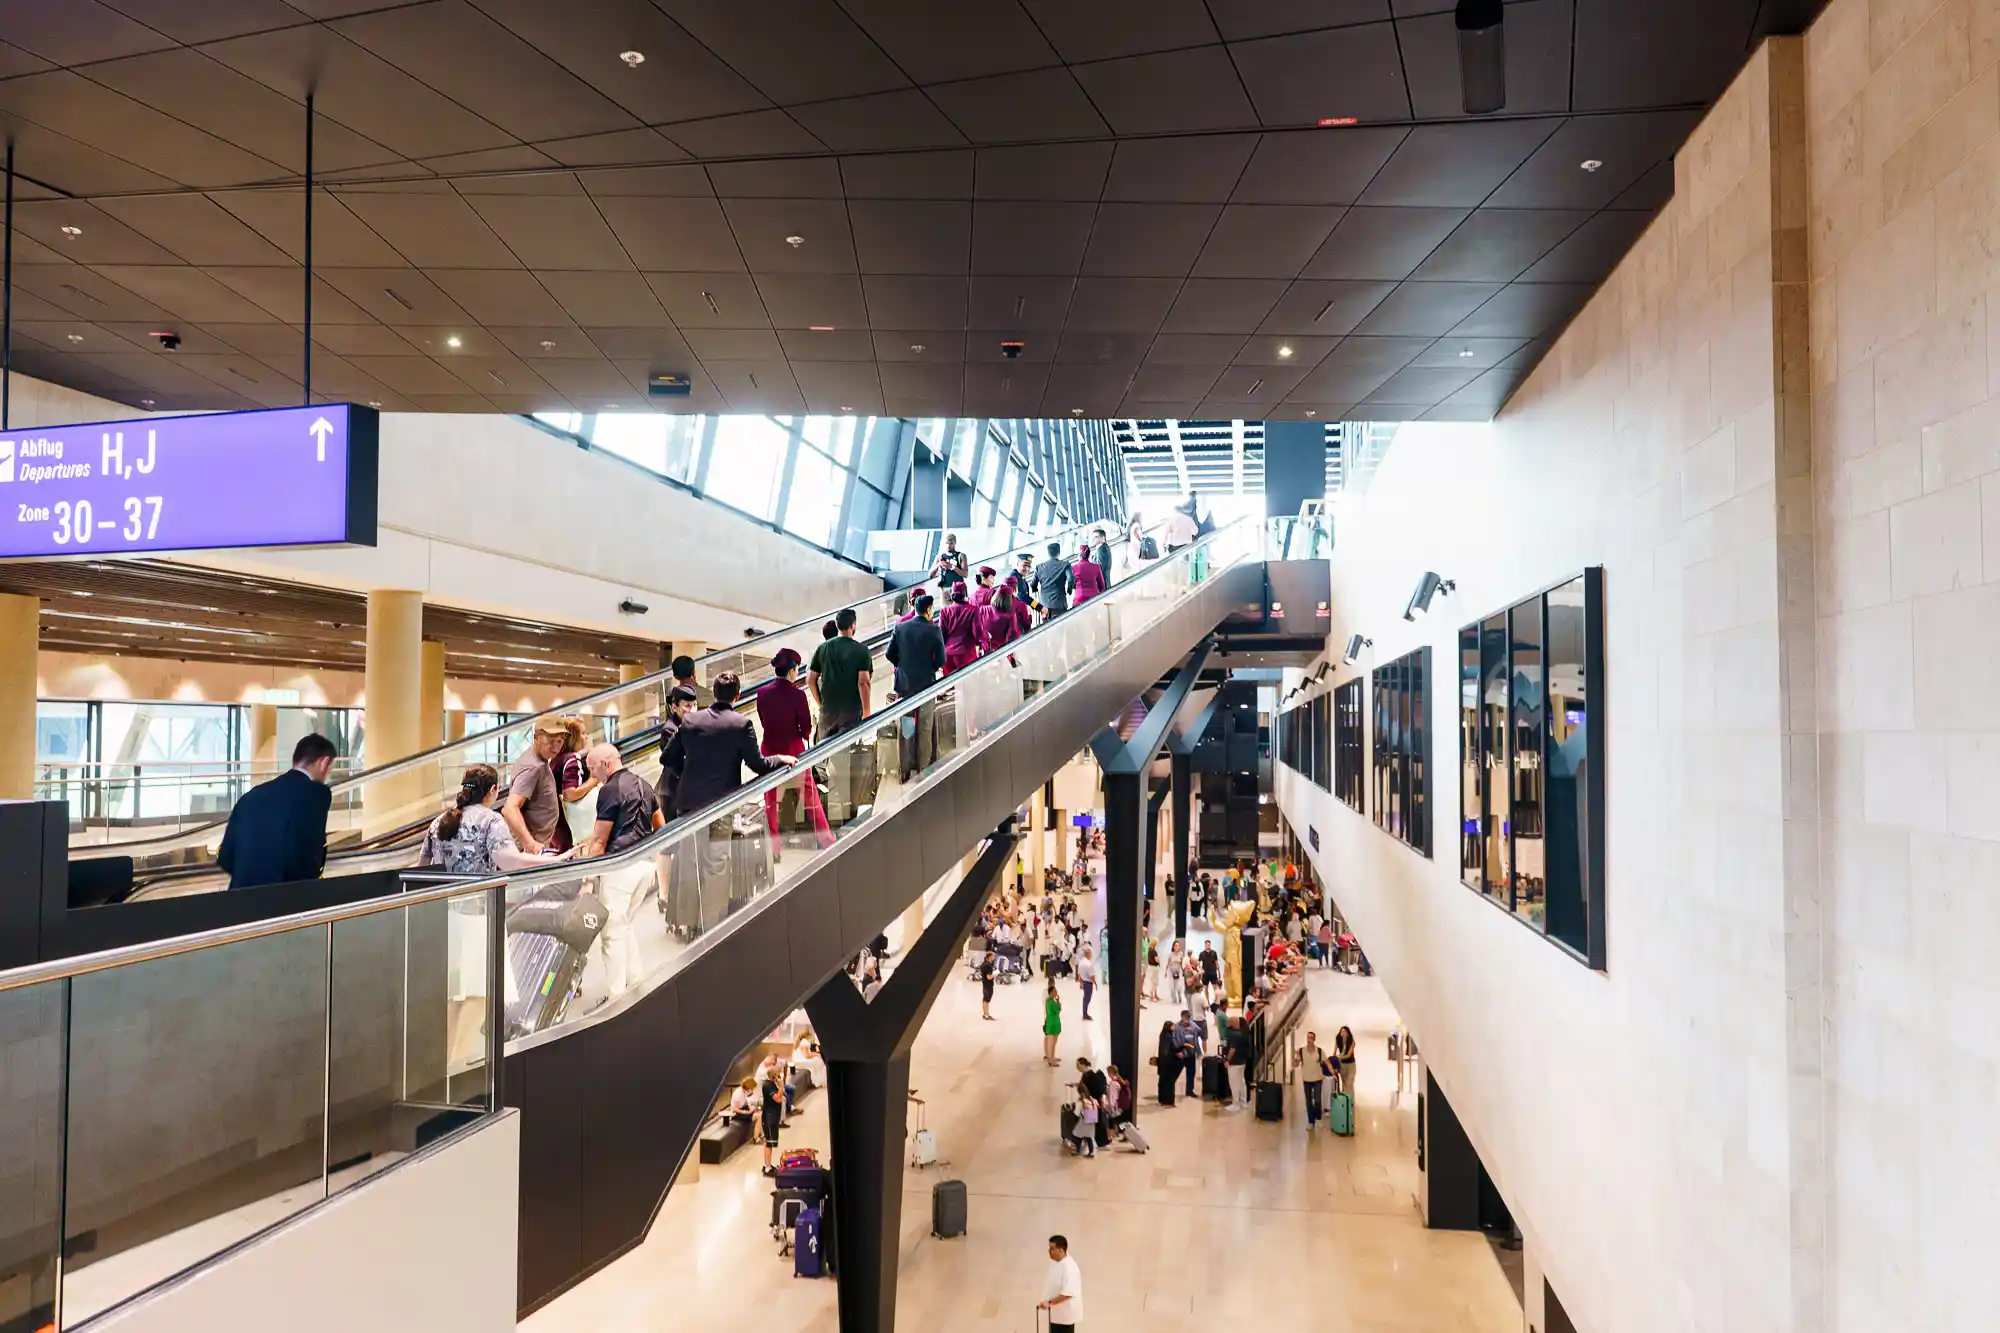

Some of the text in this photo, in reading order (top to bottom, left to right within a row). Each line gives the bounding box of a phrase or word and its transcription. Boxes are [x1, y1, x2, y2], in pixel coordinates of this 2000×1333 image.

[19, 438, 64, 459] Abflug
[101, 429, 157, 481] H,J
[19, 462, 91, 484] Departures
[17, 503, 50, 522] Zone
